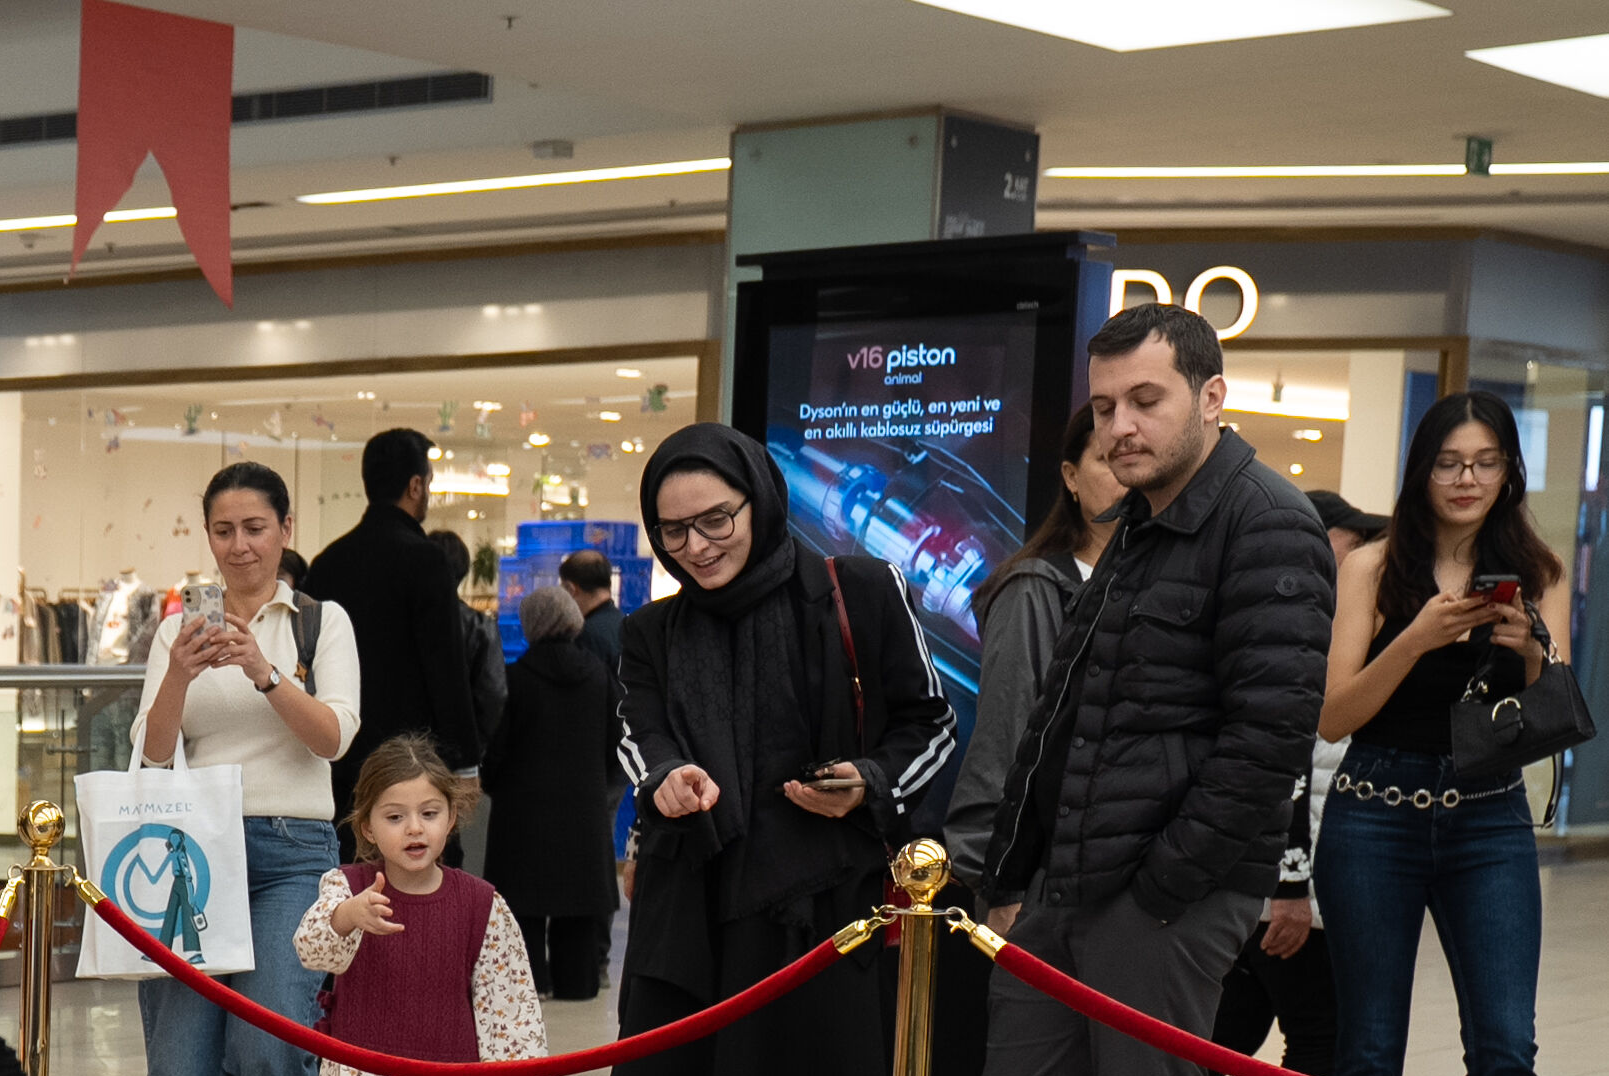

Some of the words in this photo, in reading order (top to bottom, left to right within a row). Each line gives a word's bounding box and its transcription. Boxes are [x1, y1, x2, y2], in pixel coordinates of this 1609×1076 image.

[847, 345, 883, 370] v16
[886, 342, 956, 373] piston
[884, 371, 923, 386] animal
[861, 404, 879, 417] en
[882, 397, 924, 420] güçlü,
[928, 401, 947, 413] en
[950, 395, 980, 416] yeni
[983, 398, 1001, 412] ve
[804, 426, 822, 440] en
[825, 423, 857, 438] akıllı
[860, 420, 921, 438] kablosuz
[924, 416, 994, 439] süpürgesi
